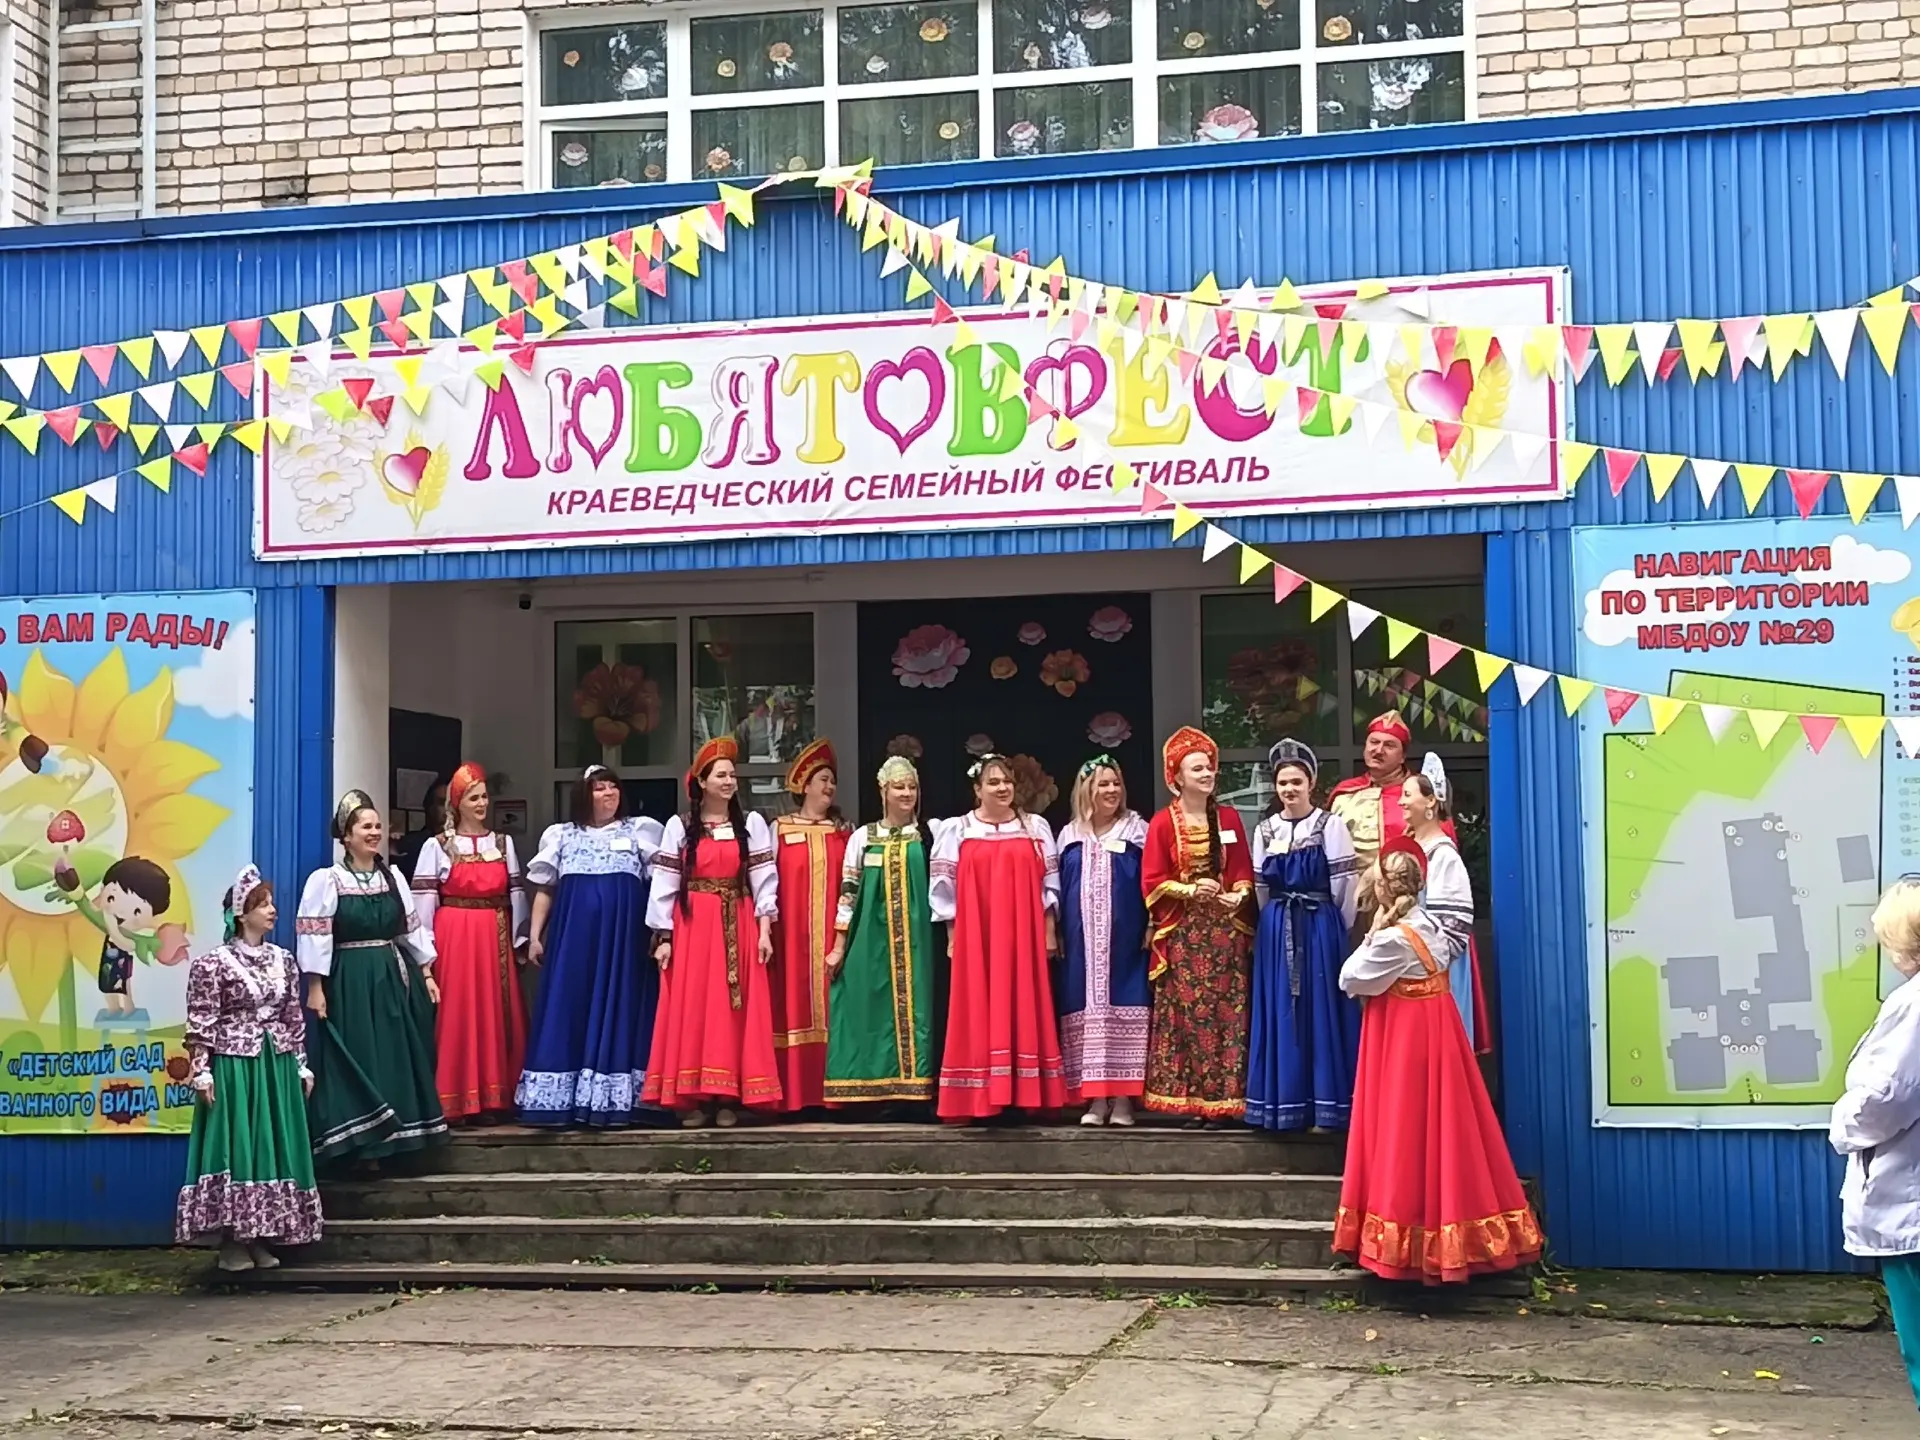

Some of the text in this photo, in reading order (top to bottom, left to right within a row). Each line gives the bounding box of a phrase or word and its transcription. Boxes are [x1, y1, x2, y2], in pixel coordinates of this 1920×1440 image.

[547, 470, 834, 515] КРАЕВЕДЧЕСКИЙ
[844, 460, 1045, 501] СЕМЕЙНЫЙ
[1634, 546, 1831, 578] НАВИГАЦИЯ
[1601, 581, 1869, 615] ПО ТЕРРИТОРИИ
[18, 612, 94, 644] ВАМ
[105, 612, 229, 650] РАДЫ!
[1637, 618, 1834, 652] МБДОУ №29
[8, 1042, 165, 1081] «ДЕТСКИЙ САД
[101, 1086, 159, 1117] ВИДА
